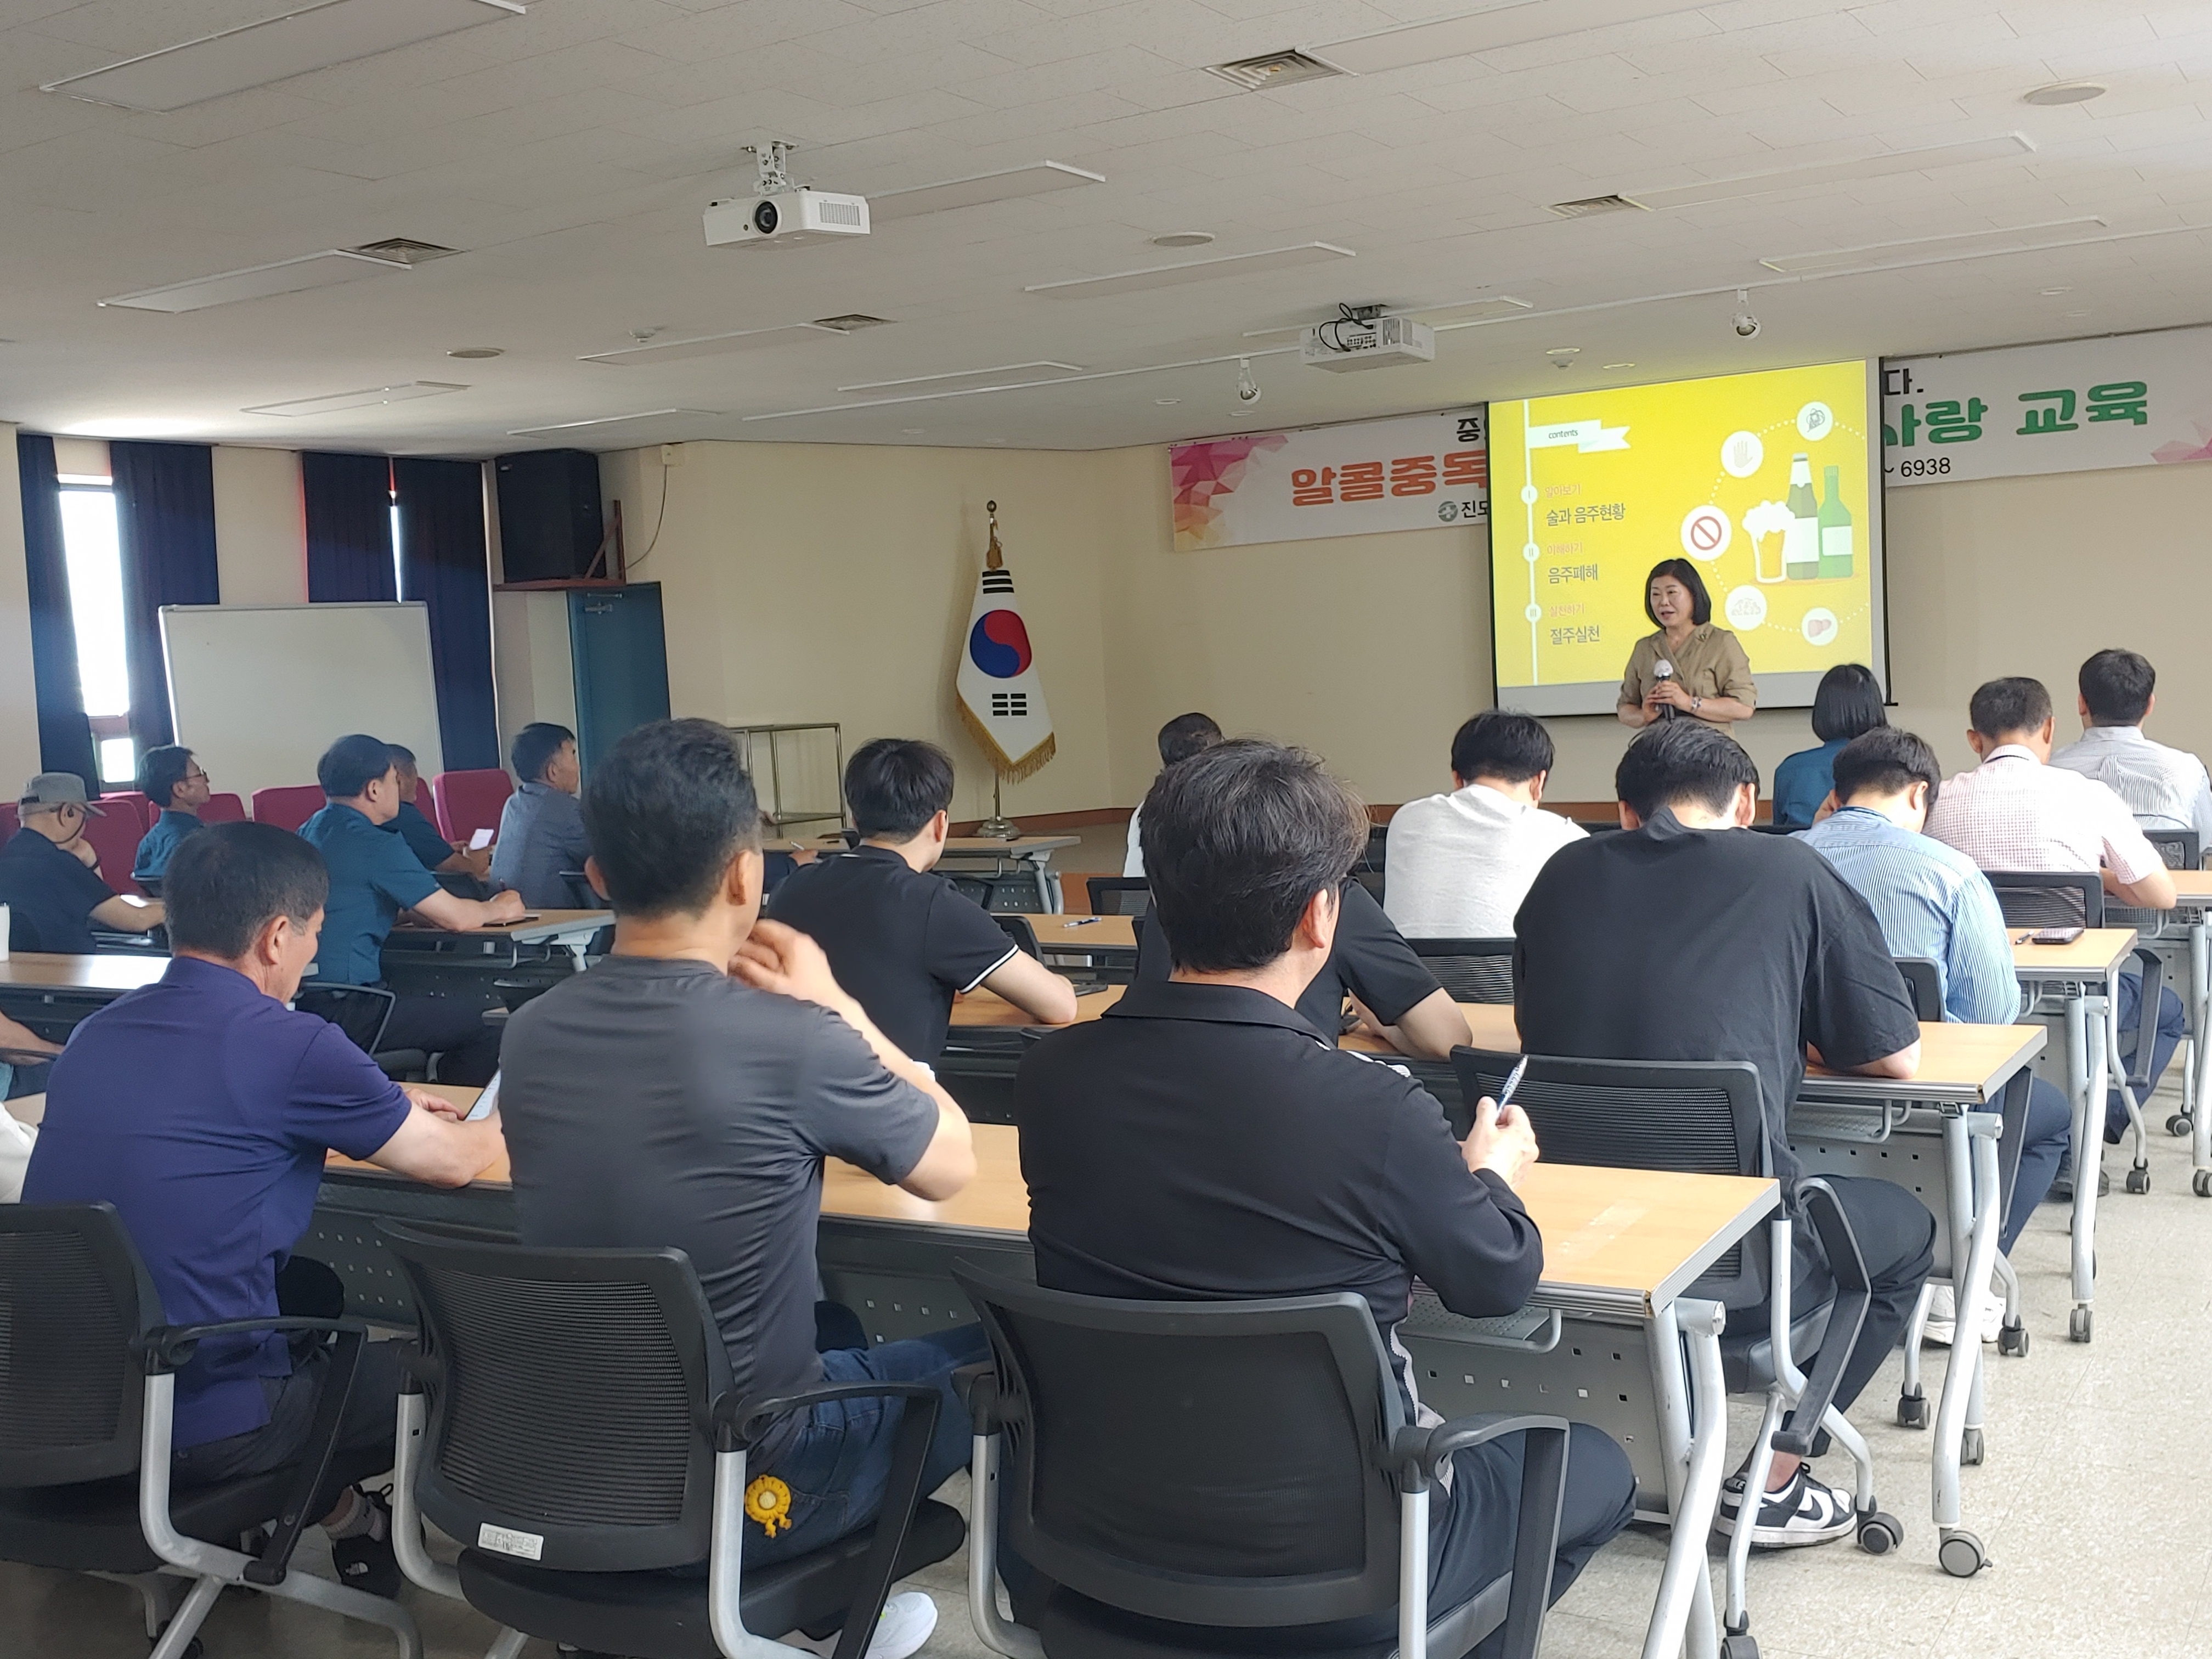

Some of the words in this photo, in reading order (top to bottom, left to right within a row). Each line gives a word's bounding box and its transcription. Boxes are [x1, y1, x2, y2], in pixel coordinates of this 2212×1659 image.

[2016, 381, 2147, 436] 교육
[1548, 430, 1578, 439] contents
[1901, 457, 1951, 477] 6938
[1291, 449, 1487, 506] 알콜중독
[1545, 484, 1582, 498] 알아보기
[1546, 507, 1572, 527] 술과
[1574, 503, 1626, 523] 음주현황
[1547, 542, 1583, 555] 이해하기
[1549, 603, 1584, 618] 실천하기
[1550, 624, 1600, 645] 절주실천
